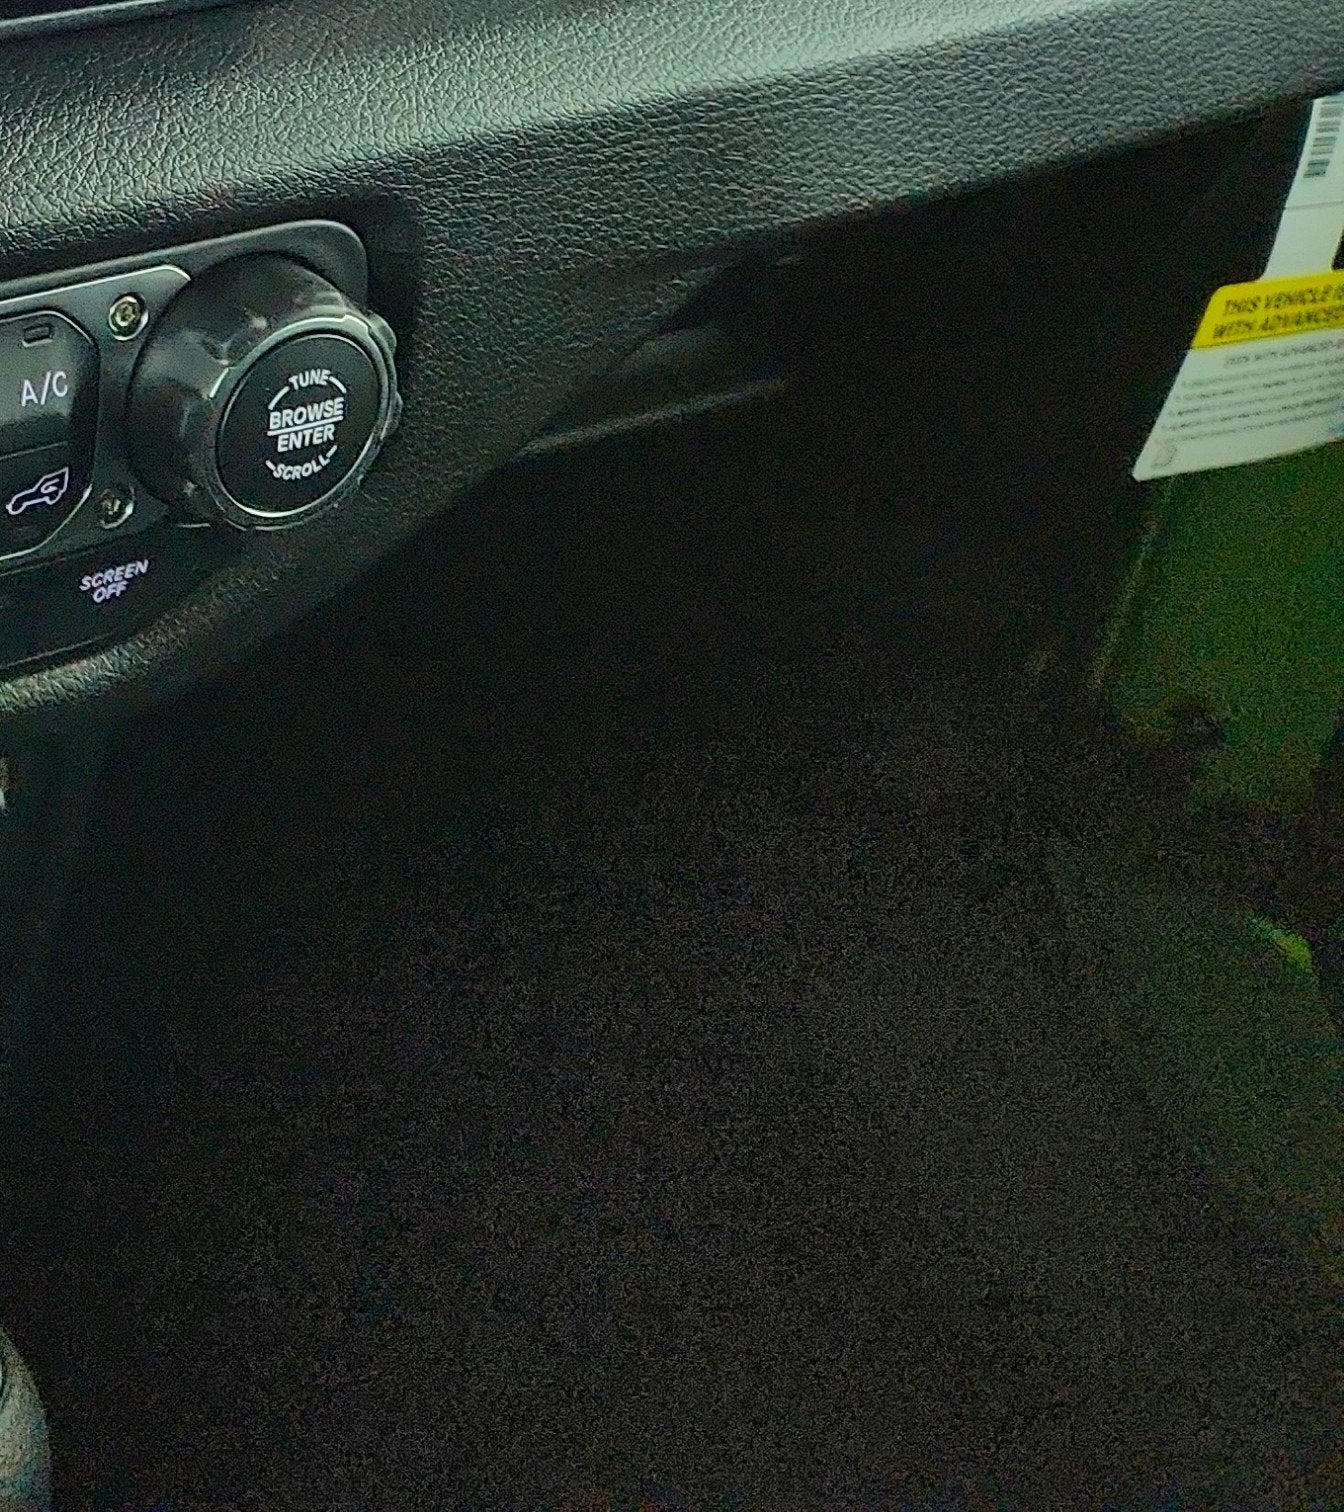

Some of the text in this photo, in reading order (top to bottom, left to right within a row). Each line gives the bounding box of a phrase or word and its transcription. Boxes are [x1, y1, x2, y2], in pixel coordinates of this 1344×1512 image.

[20, 369, 69, 408] A/C
[288, 368, 331, 392] TUNE
[269, 397, 345, 430] BROWSE
[277, 424, 335, 453] ENTER
[273, 454, 330, 481] SCROLL
[79, 559, 149, 593] SCREEN
[92, 580, 128, 604] OFF
